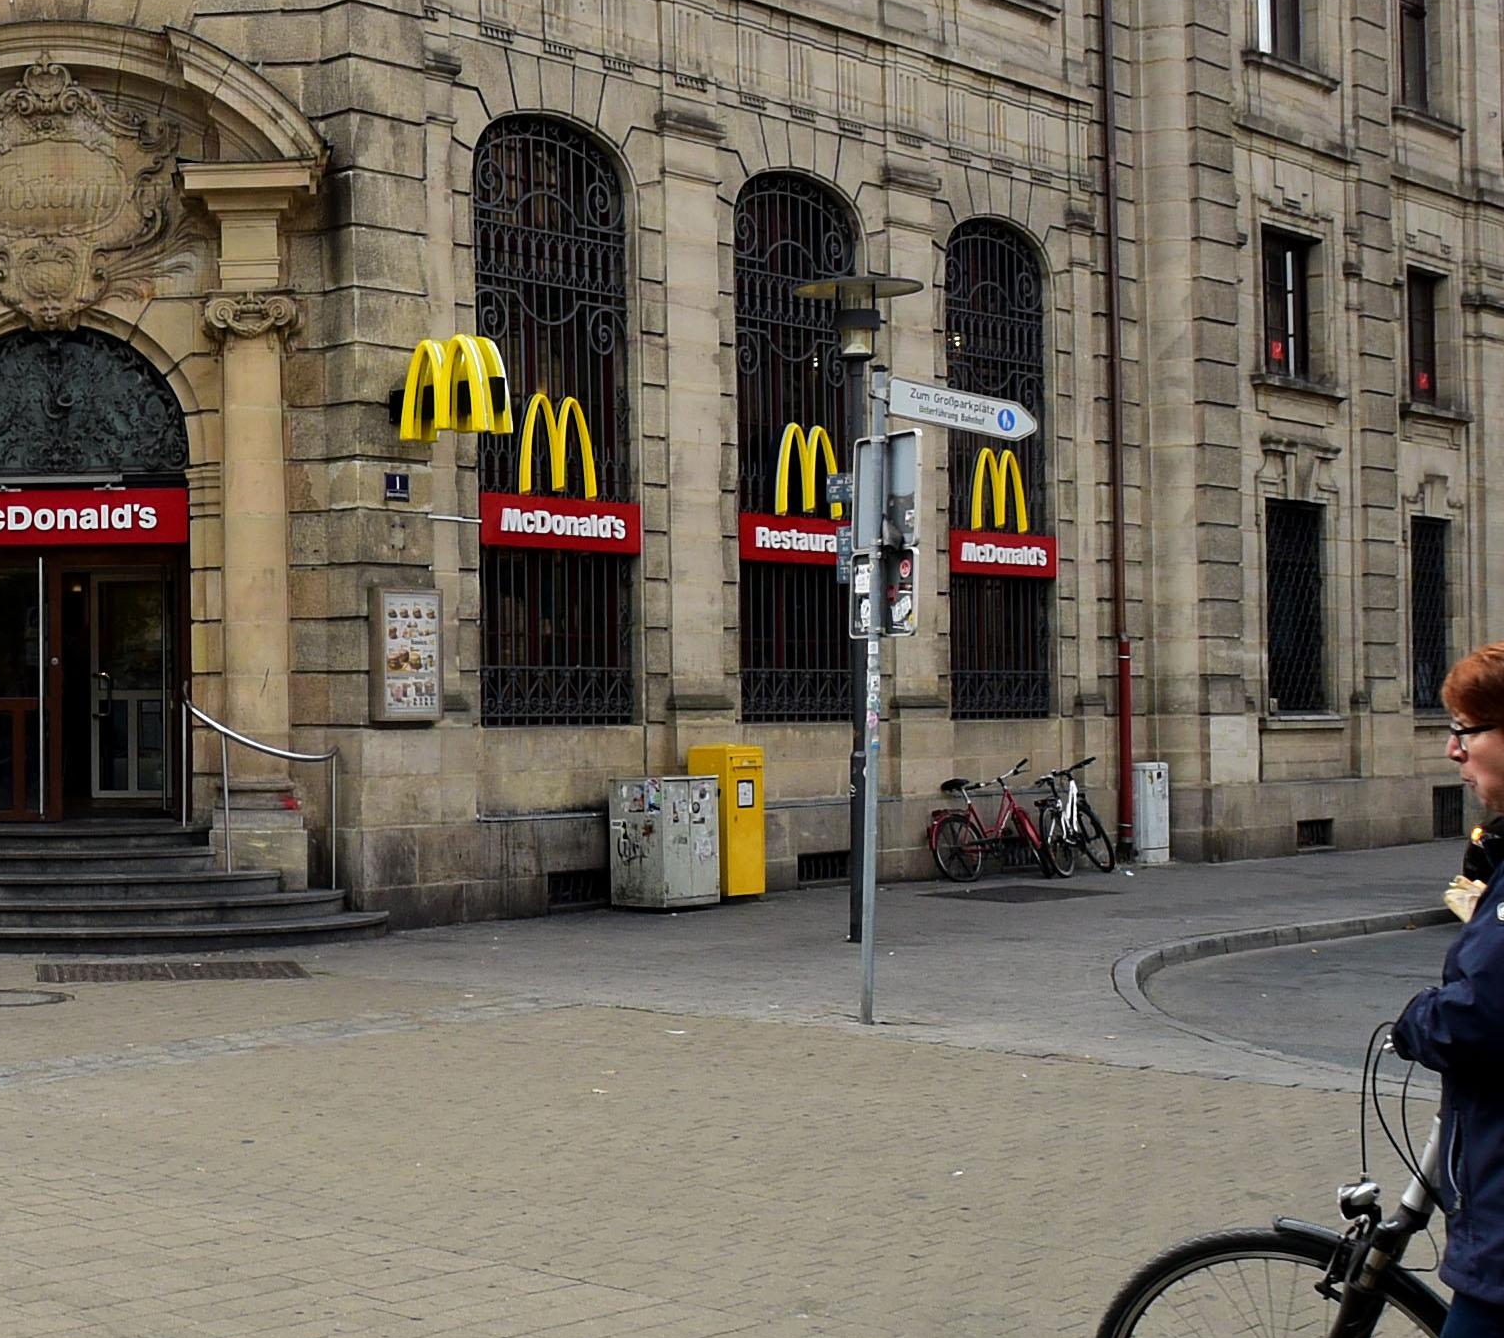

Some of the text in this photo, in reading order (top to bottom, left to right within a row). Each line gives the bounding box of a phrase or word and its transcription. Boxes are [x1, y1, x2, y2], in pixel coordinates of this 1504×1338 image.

[909, 387, 995, 415] Zum Großparkplatz
[961, 413, 985, 425] Bahnhof
[500, 508, 627, 540] McDonald's
[755, 526, 838, 553] Restaura
[961, 541, 1048, 567] McDonald's
